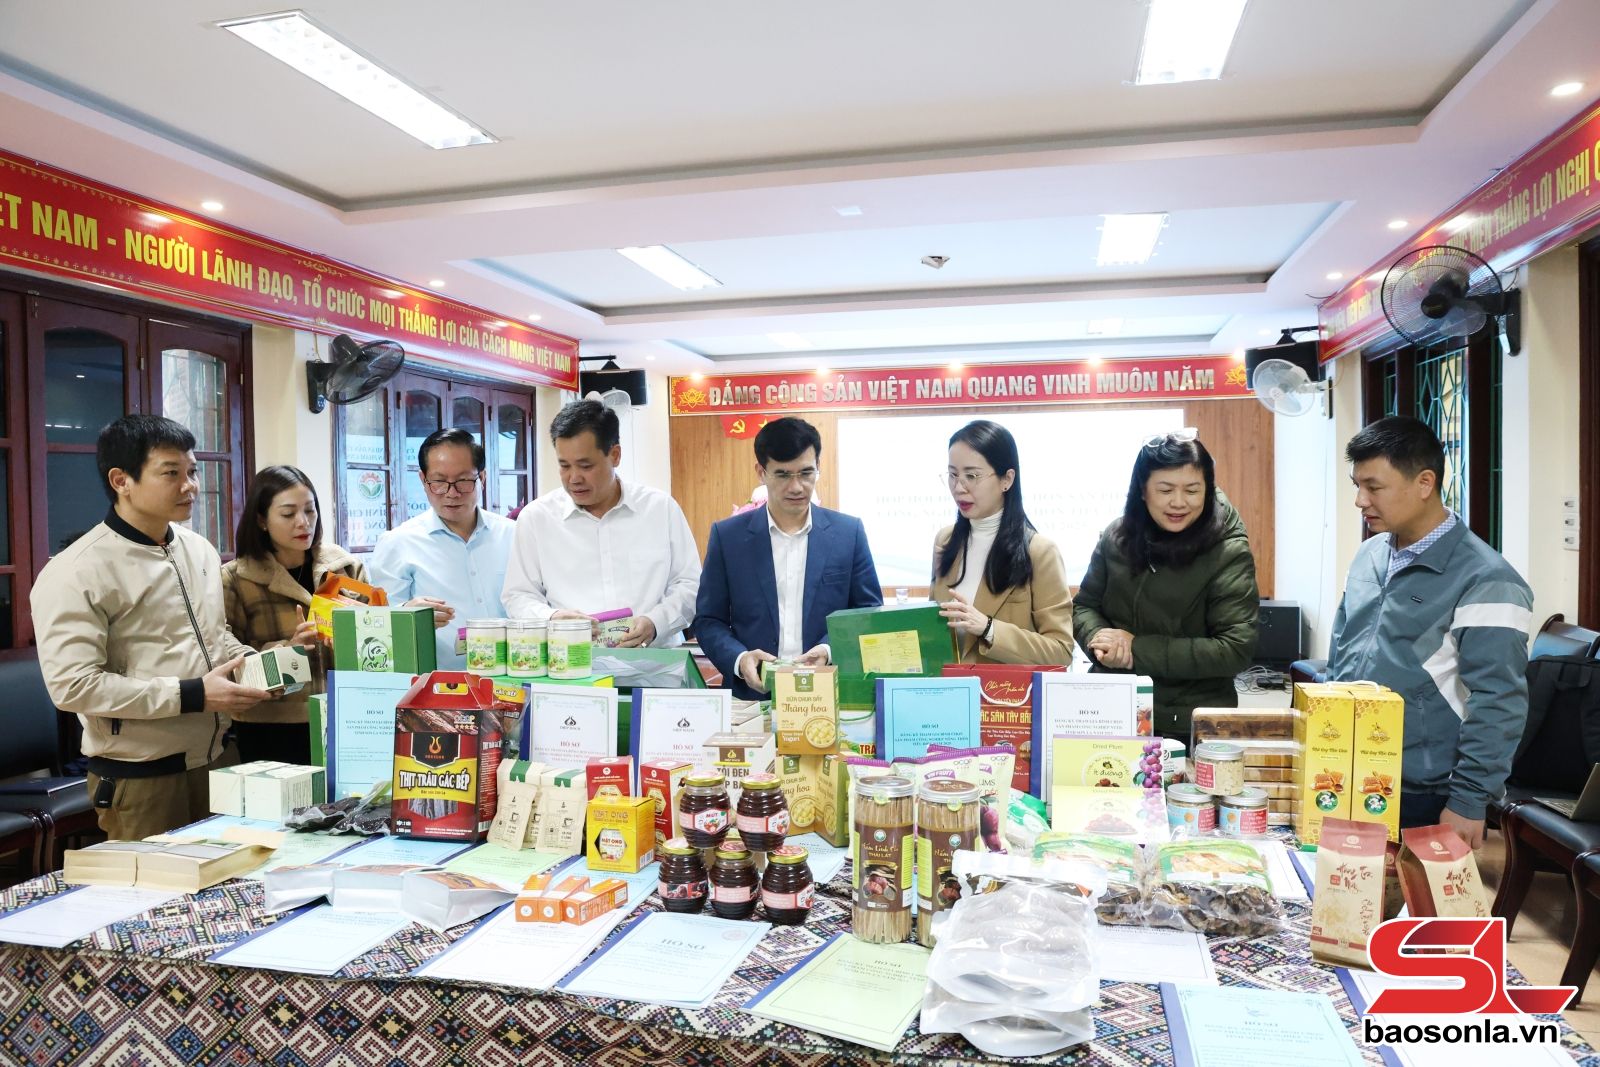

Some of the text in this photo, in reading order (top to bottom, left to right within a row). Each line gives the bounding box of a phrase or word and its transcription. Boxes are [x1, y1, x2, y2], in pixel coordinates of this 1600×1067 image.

[1556, 148, 1590, 205] NGHỊ
[32, 201, 98, 250] NAM
[125, 228, 195, 276] NGƯỜI
[202, 249, 253, 291] LÃNH
[258, 266, 298, 305] ĐẠO,
[302, 274, 321, 308] TỔ
[327, 287, 365, 320] CHỨC
[369, 299, 395, 331] MỌI
[399, 305, 437, 337] THẮNG
[439, 320, 457, 343] LỢI
[459, 320, 480, 349] CỦA
[482, 331, 507, 356] CÁCH
[509, 339, 534, 366] MẠNG
[535, 345, 553, 369] VIỆT
[554, 350, 571, 373] NAM
[709, 365, 1215, 408] ĐẢNG CỘNG SẢN VIỆT NAM QUANG VINH MUÔN NĂM
[811, 703, 828, 712] hoa
[399, 768, 471, 791] THỊT TRÂU GÁC BẾP
[611, 810, 628, 818] ONG
